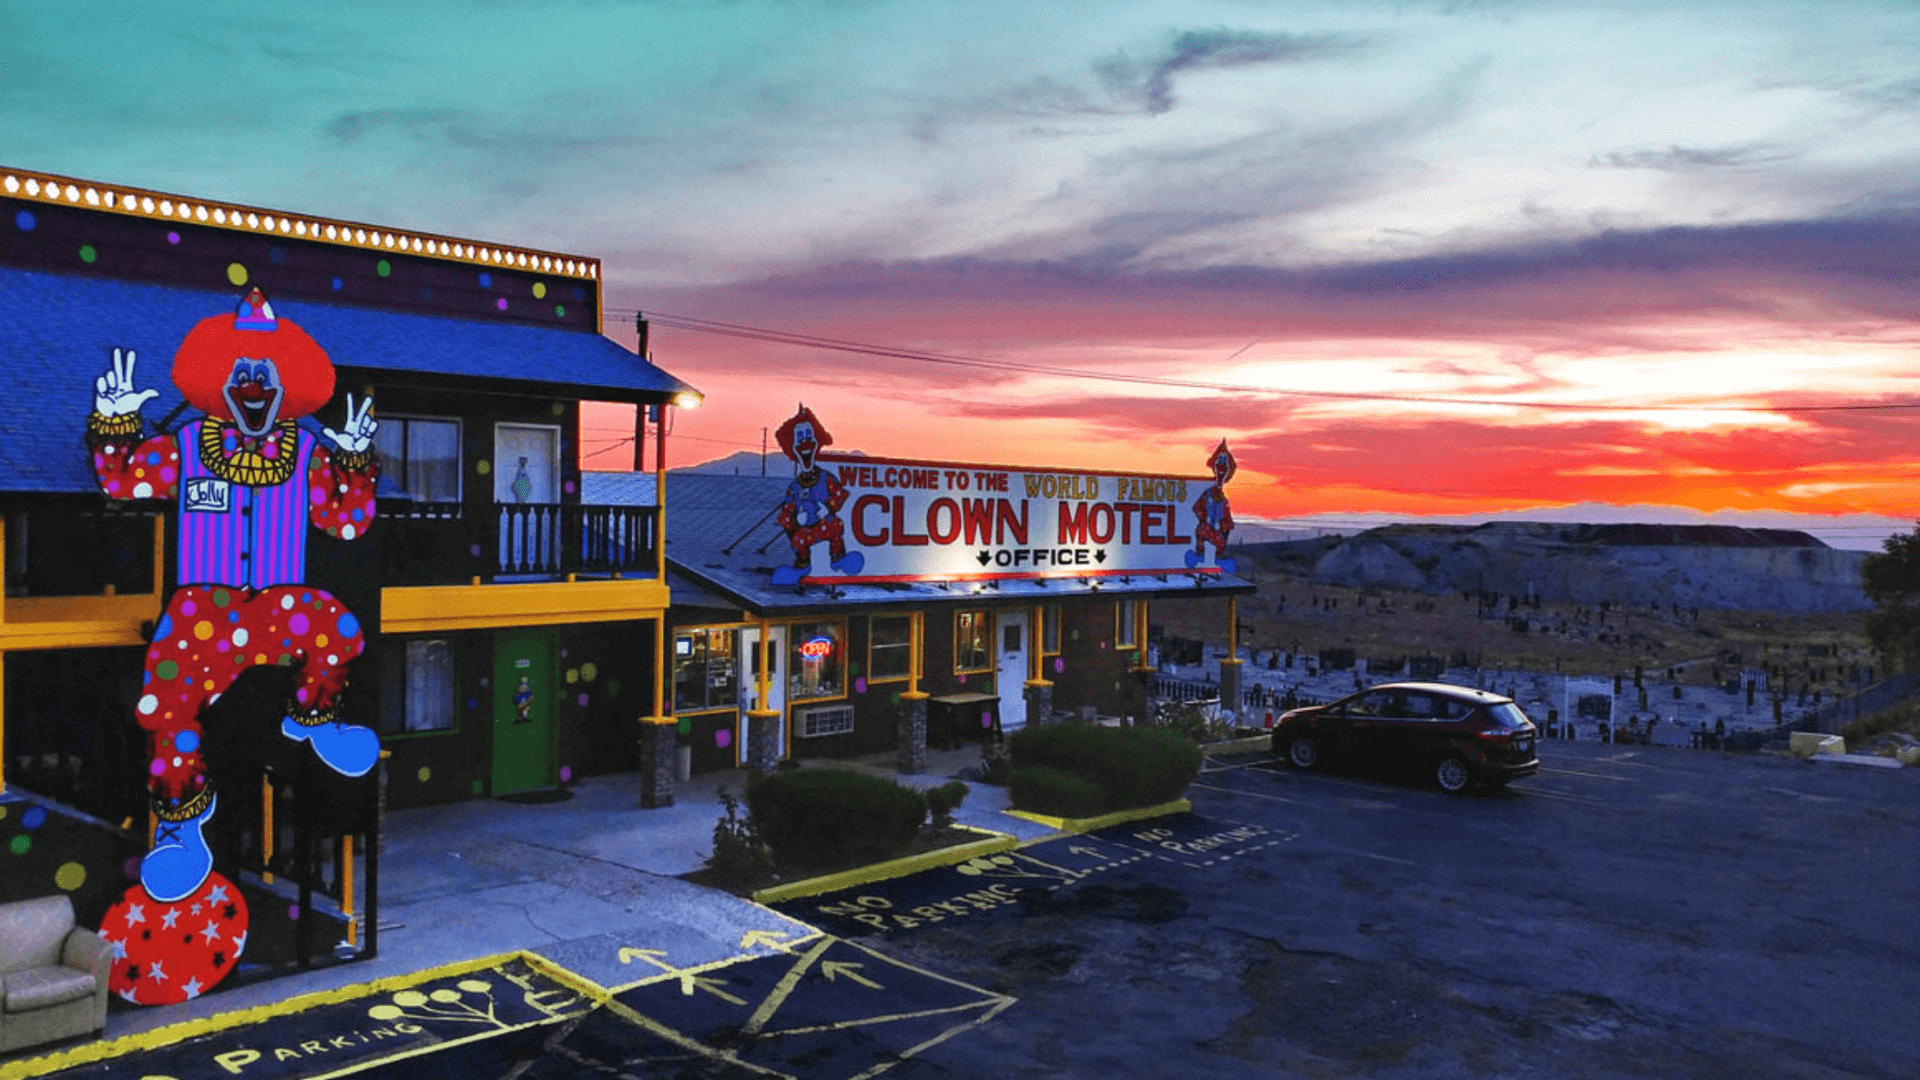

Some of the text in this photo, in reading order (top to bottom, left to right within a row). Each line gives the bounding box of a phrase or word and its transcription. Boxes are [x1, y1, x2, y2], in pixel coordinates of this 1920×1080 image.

[187, 480, 226, 507] Jolly
[838, 465, 1188, 503] WELCOME TO THE WORLD FAMOUS
[852, 493, 1192, 546] CLOWN MOTEL
[995, 549, 1090, 568] OFFICE
[1132, 828, 1174, 842] NO
[818, 895, 893, 916] NO
